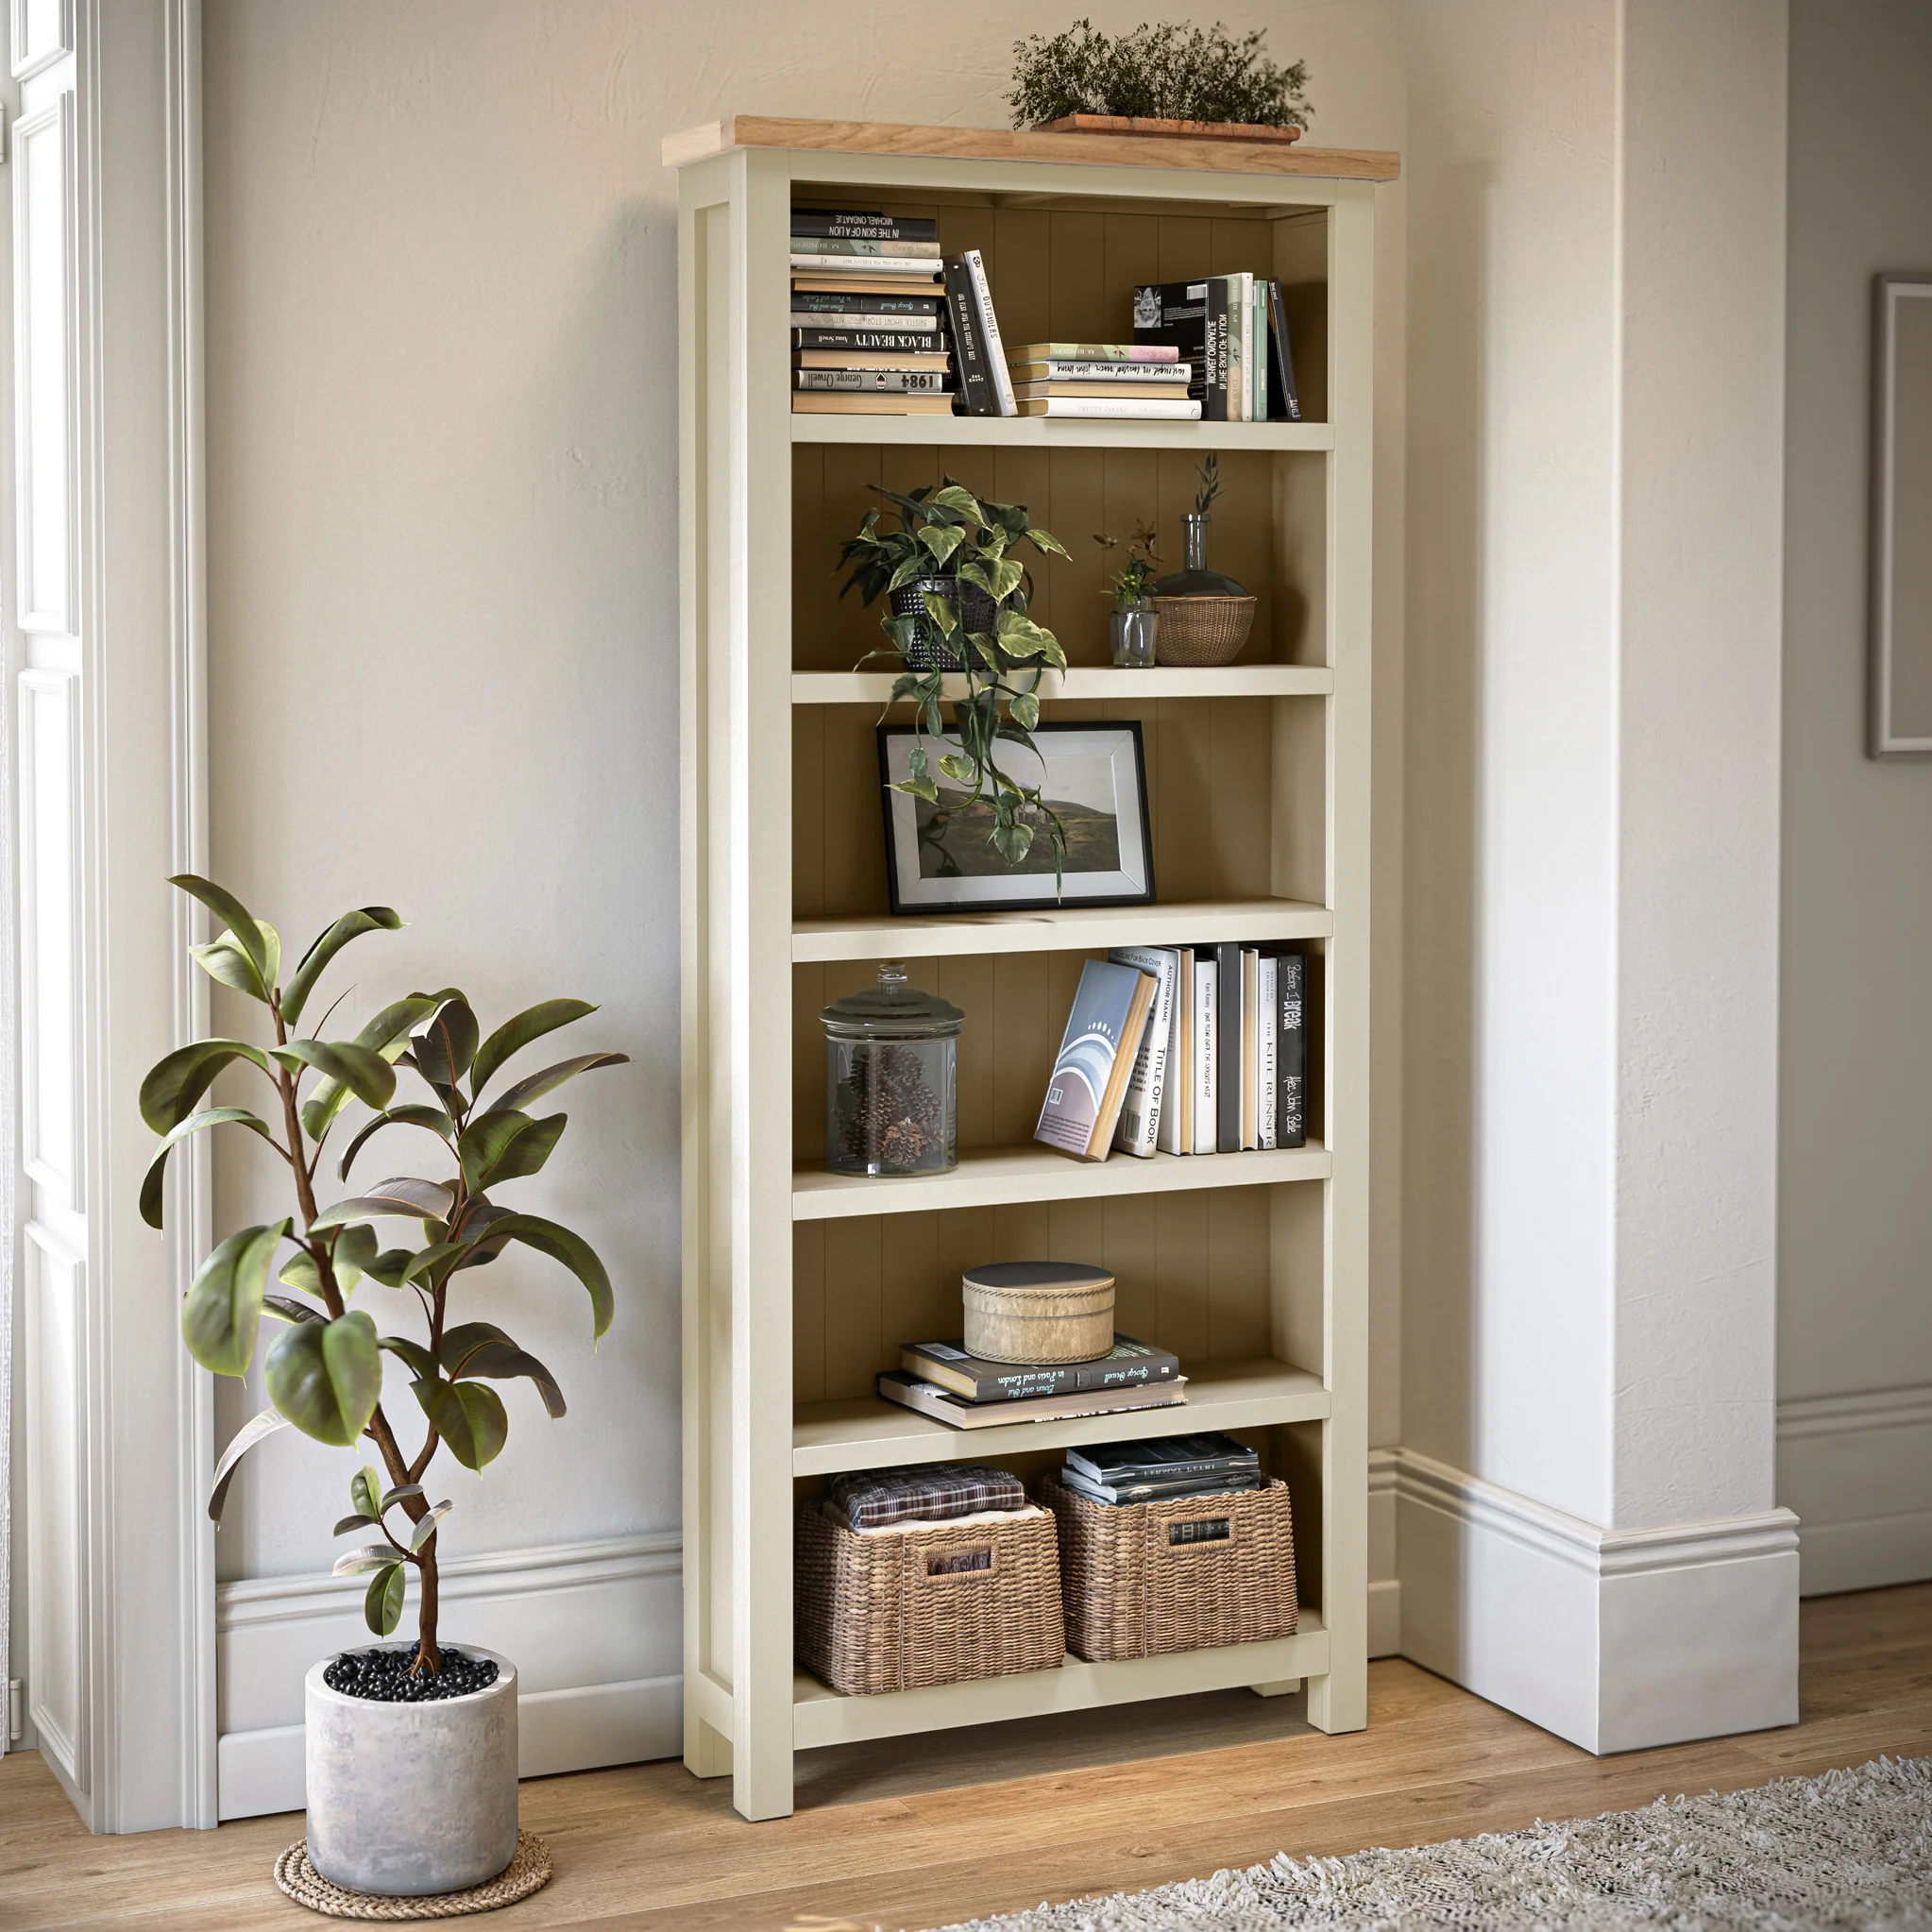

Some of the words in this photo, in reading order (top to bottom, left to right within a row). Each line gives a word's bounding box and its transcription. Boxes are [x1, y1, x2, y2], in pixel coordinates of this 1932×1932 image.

[836, 214, 867, 225] ONDAATJE
[867, 215, 893, 226] MICHAEL
[829, 226, 844, 236] LION
[845, 227, 850, 236] A
[851, 227, 860, 236] OF
[861, 228, 877, 238] SKIN
[878, 229, 891, 238] THE
[892, 229, 899, 238] IN
[884, 317, 903, 327] SHORT
[983, 296, 997, 338] OUTSIDERS
[854, 334, 895, 347] BEAUTY
[897, 335, 932, 347] BLACK
[1076, 364, 1091, 376] John
[808, 373, 834, 387] Orwell
[836, 372, 862, 388] George
[901, 375, 934, 389] 1984
[1287, 964, 1301, 990] Before
[1154, 1047, 1166, 1082] TITLE
[1151, 1086, 1161, 1105] OF
[1286, 1093, 1301, 1113] John
[1146, 1107, 1159, 1144] BOOK
[1287, 1114, 1301, 1133] Belle
[1023, 1374, 1036, 1384] and
[1127, 1366, 1148, 1380] George
[1022, 1386, 1035, 1398] and
